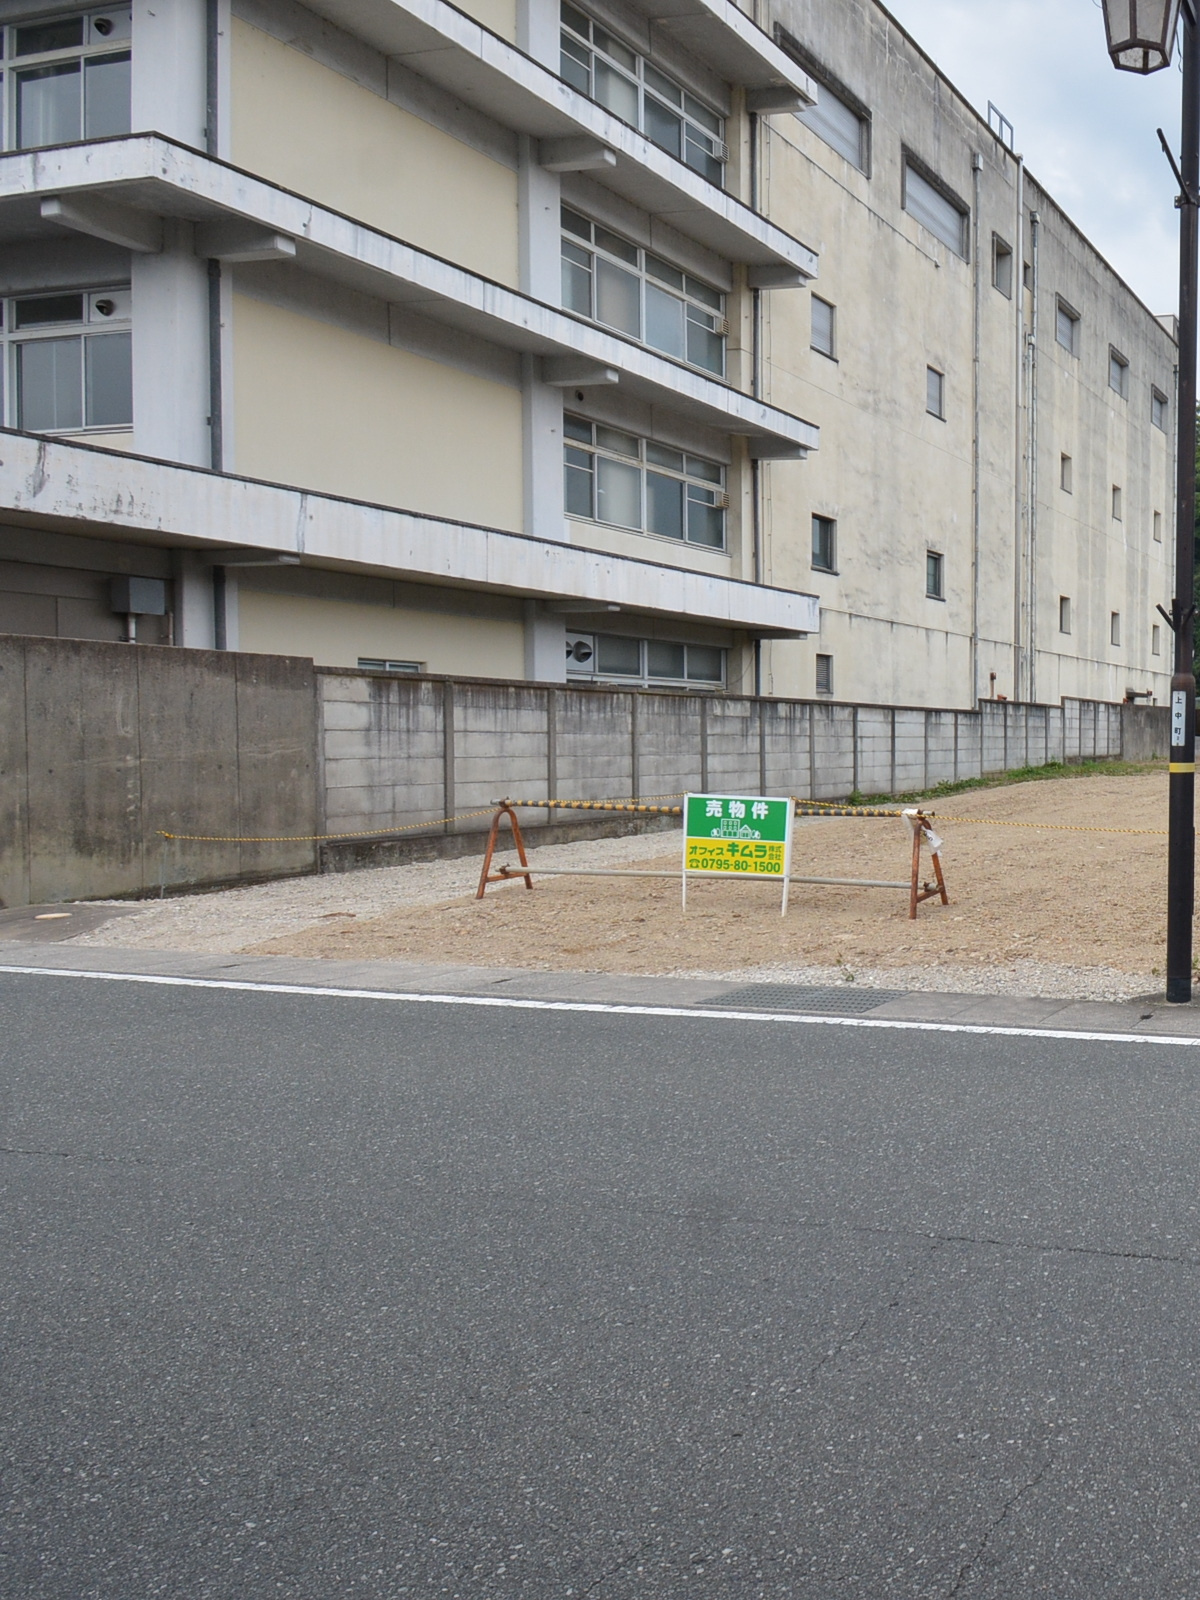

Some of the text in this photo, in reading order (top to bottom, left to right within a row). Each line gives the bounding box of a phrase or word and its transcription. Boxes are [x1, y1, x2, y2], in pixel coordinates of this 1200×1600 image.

[1174, 696, 1183, 735] 上中町
[705, 800, 769, 820] 売物件
[689, 842, 767, 858] オフィスキムラ
[701, 858, 781, 873] 0795-80-1500
